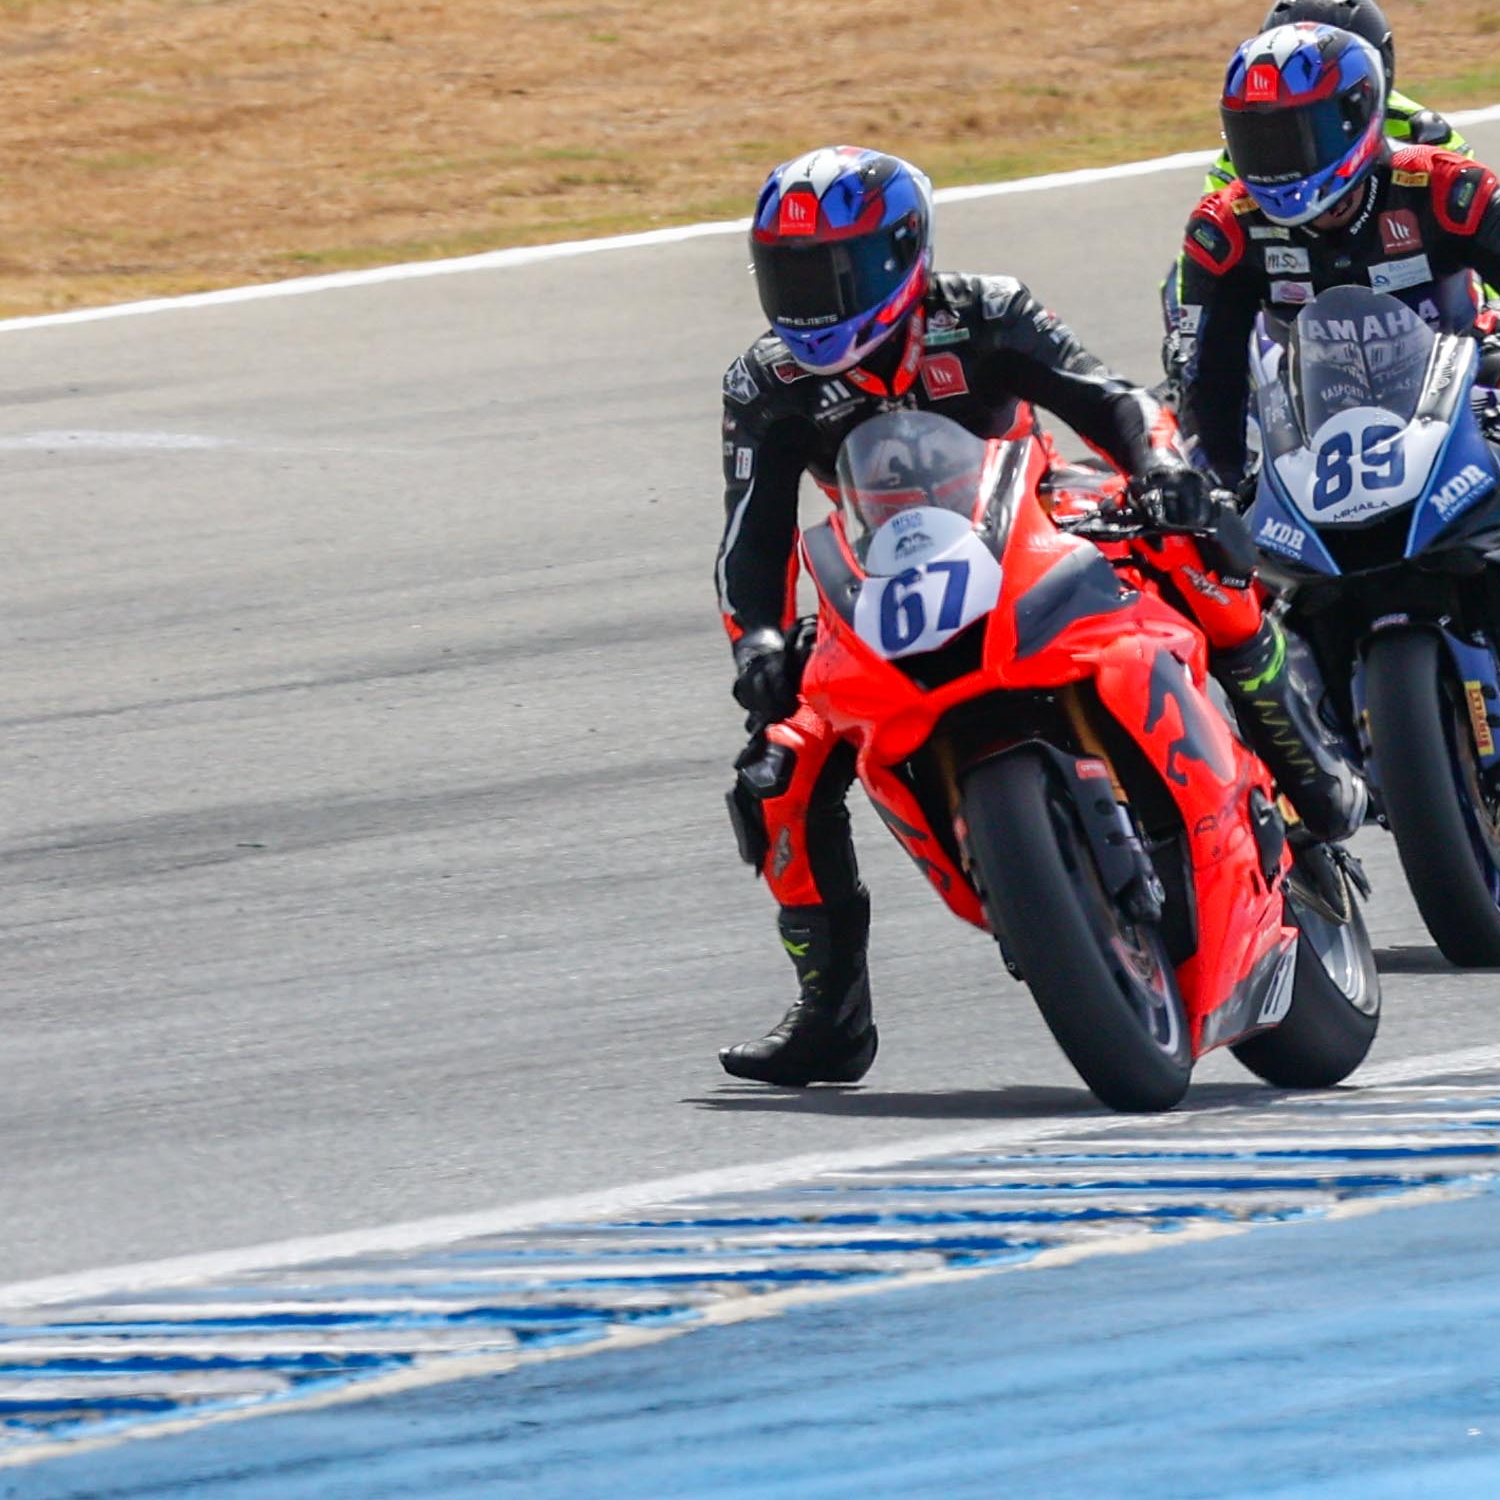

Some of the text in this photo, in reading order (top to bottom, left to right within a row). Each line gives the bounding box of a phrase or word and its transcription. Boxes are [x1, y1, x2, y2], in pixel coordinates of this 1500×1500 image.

[1313, 425, 1406, 512] 89
[1430, 464, 1487, 514] MDR
[1260, 517, 1306, 550] MDR
[880, 560, 970, 653] 67
